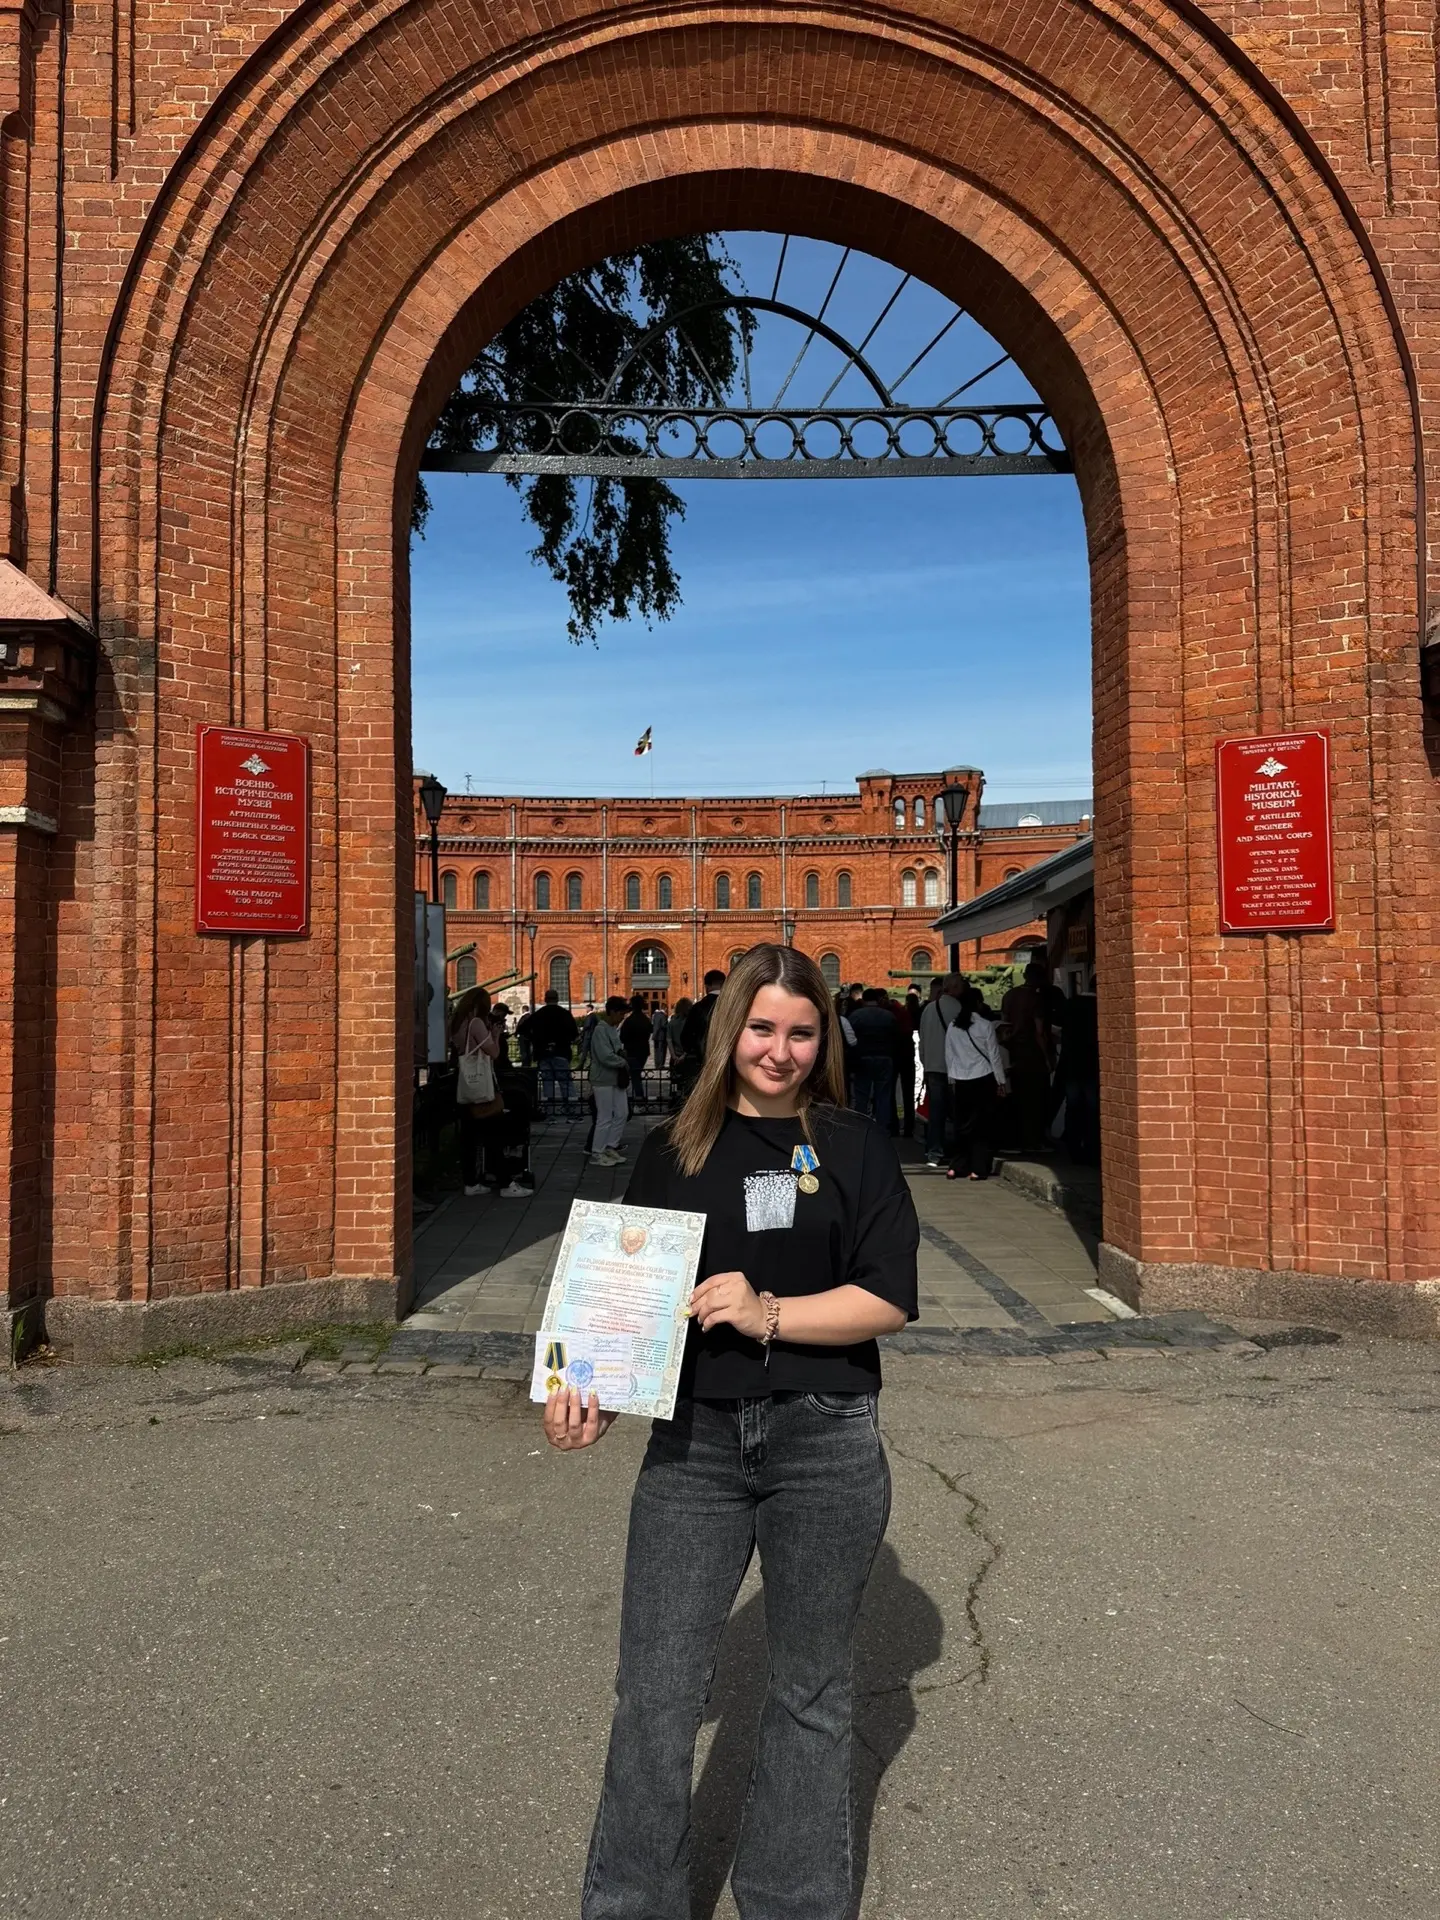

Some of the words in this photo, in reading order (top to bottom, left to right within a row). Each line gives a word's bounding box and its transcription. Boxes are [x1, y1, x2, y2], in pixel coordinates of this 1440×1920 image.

[236, 778, 278, 790] ВОЕННО-
[1249, 780, 1300, 792] MILITARY-
[215, 786, 294, 800] ИСТОРИЧЕСКИЙ
[1244, 790, 1302, 802] HISTORICAL
[238, 798, 272, 808] МУЗЕЙ
[1252, 800, 1296, 810] MUSEUM
[212, 820, 268, 830] ИНЖЕНЕРНЫХ
[1254, 822, 1294, 831] ENGINEER
[1286, 832, 1313, 840] CORPS
